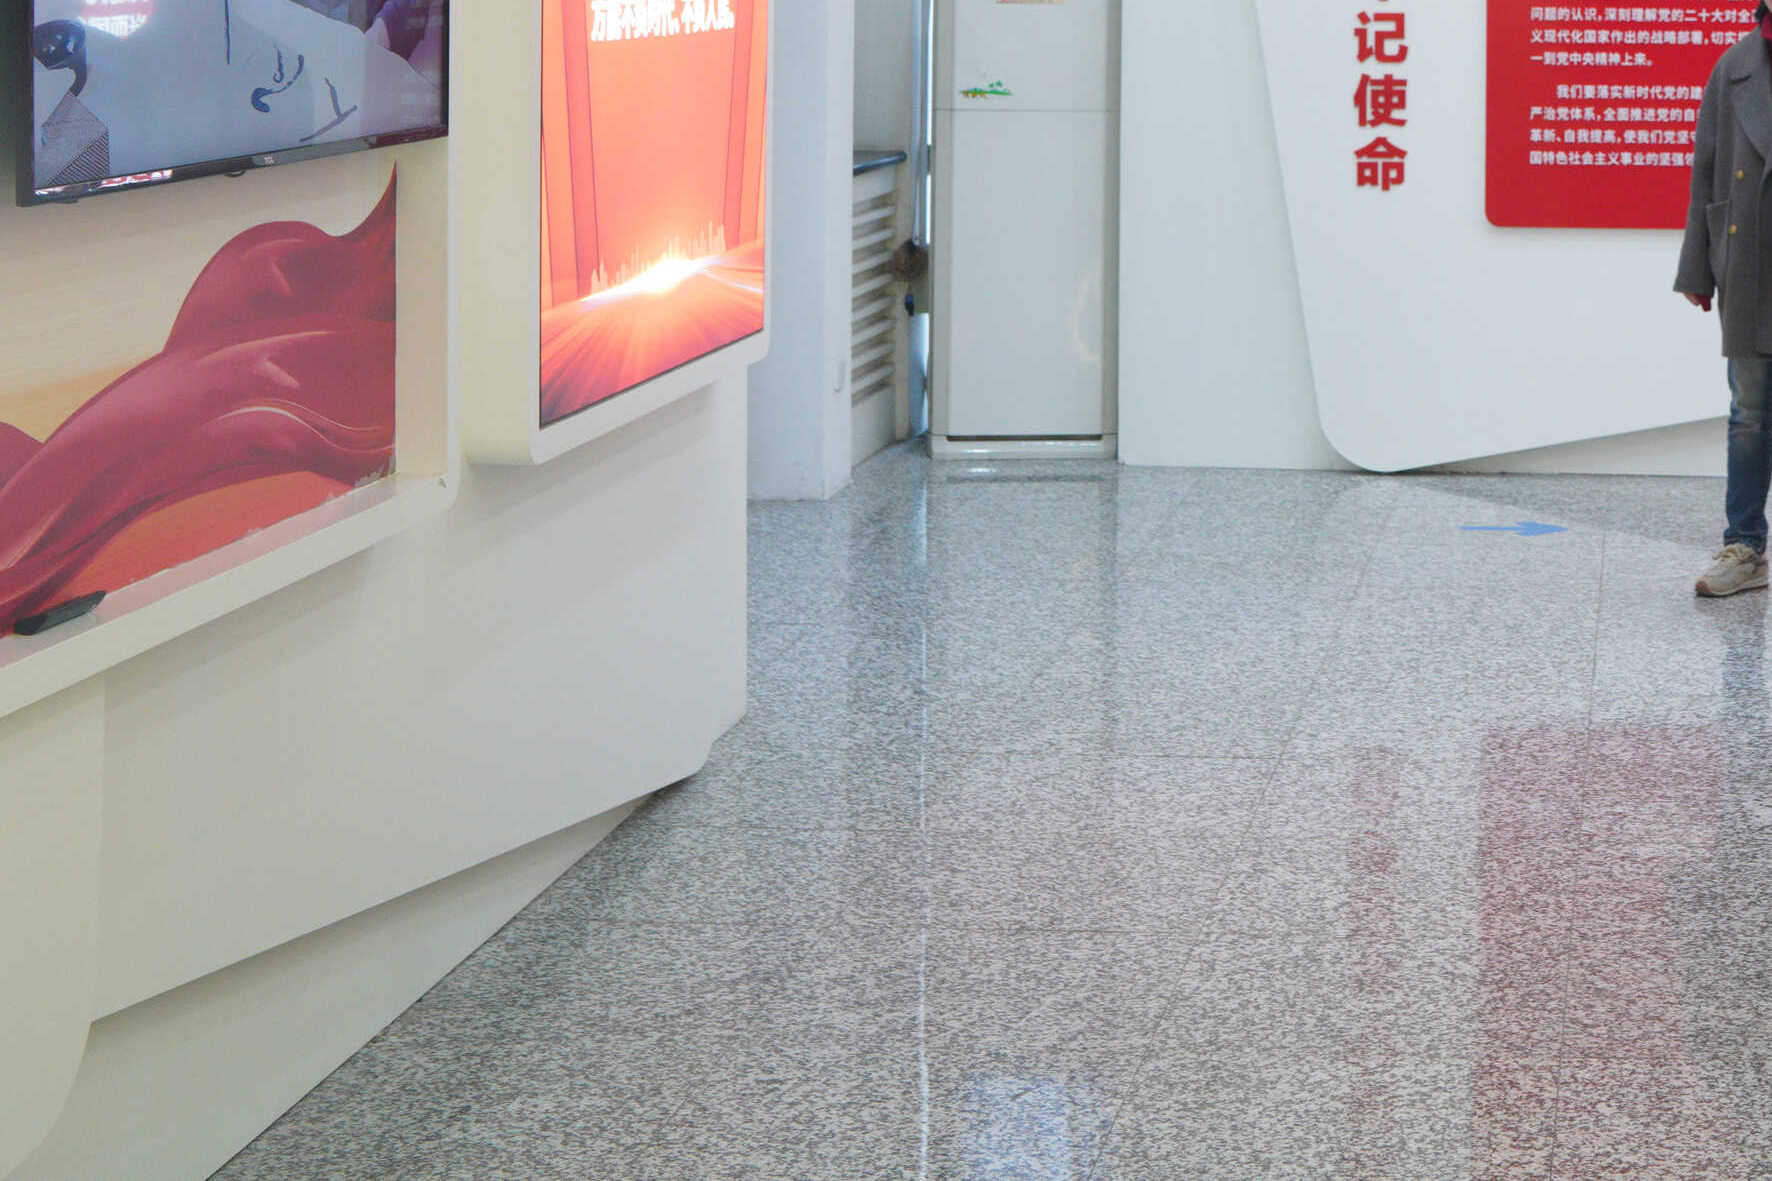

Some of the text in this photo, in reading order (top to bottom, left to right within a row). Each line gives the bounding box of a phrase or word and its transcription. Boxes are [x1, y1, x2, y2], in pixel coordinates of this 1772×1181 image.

[1530, 51, 1653, 66] 一到党中央精神上来。
[1557, 84, 1705, 100] 我们要落实新时代党的建
[1530, 106, 1700, 122] 严治党体系，全面推进党的自
